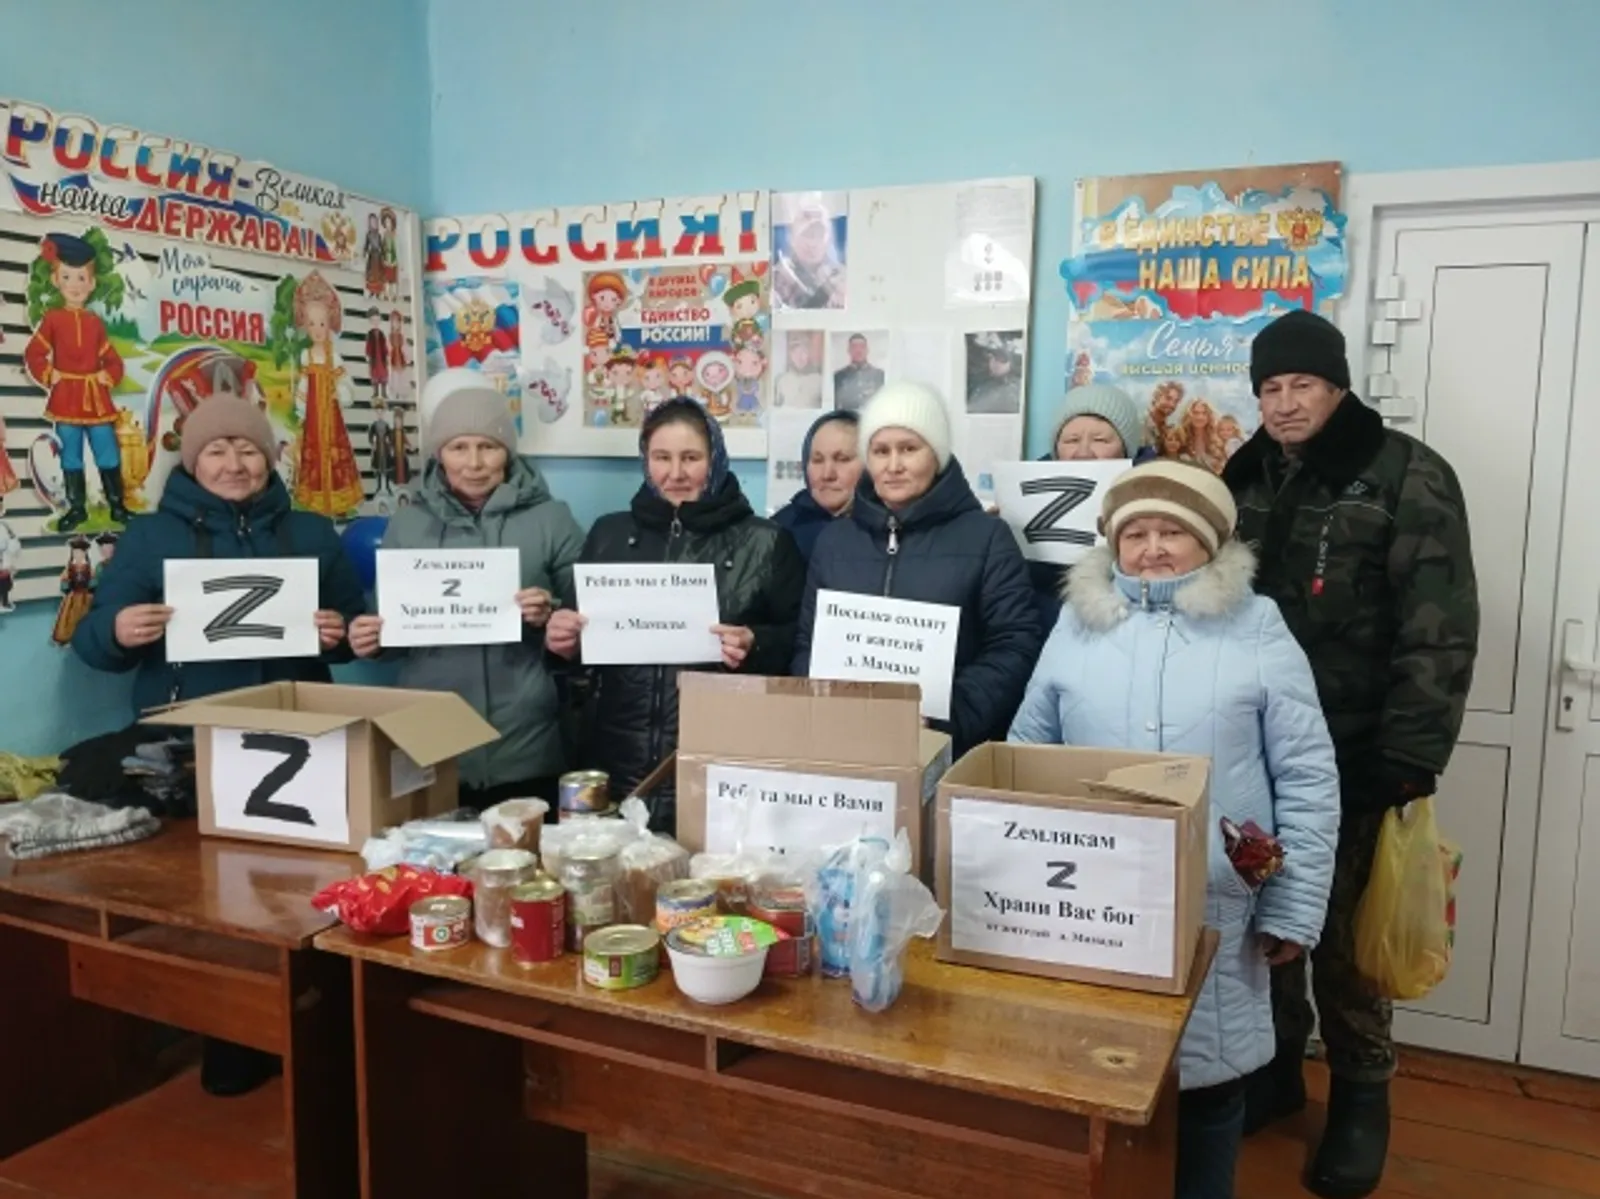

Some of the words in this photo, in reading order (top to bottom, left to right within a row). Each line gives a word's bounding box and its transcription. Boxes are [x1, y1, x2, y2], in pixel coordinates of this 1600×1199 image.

[255, 167, 346, 211] Великая
[40, 181, 129, 218] наша
[138, 200, 316, 259] ДЕРЖАВА!
[424, 190, 761, 272] РОССИЯ!
[1100, 221, 1117, 248] В
[1125, 213, 1270, 254] ЕДИНСТВЕ
[1139, 257, 1221, 290] НАША
[1232, 255, 1311, 290] СИЛА
[160, 299, 266, 345] РОССИЯ
[641, 307, 710, 324] ЕДИНСТВО
[641, 325, 711, 345] РОССИИ!
[1147, 320, 1234, 360] Семья
[1020, 476, 1097, 546] Z
[441, 579, 461, 597] Z
[202, 575, 285, 642] Z
[241, 732, 317, 827] Z
[784, 791, 812, 805] мы
[818, 796, 828, 807] с
[833, 791, 883, 812] Вами
[1003, 821, 1116, 850] Zемлякам
[1046, 861, 1077, 890] Z
[983, 890, 1051, 916] Храни
[1058, 900, 1096, 921] Вас
[1103, 906, 1138, 926] бог
